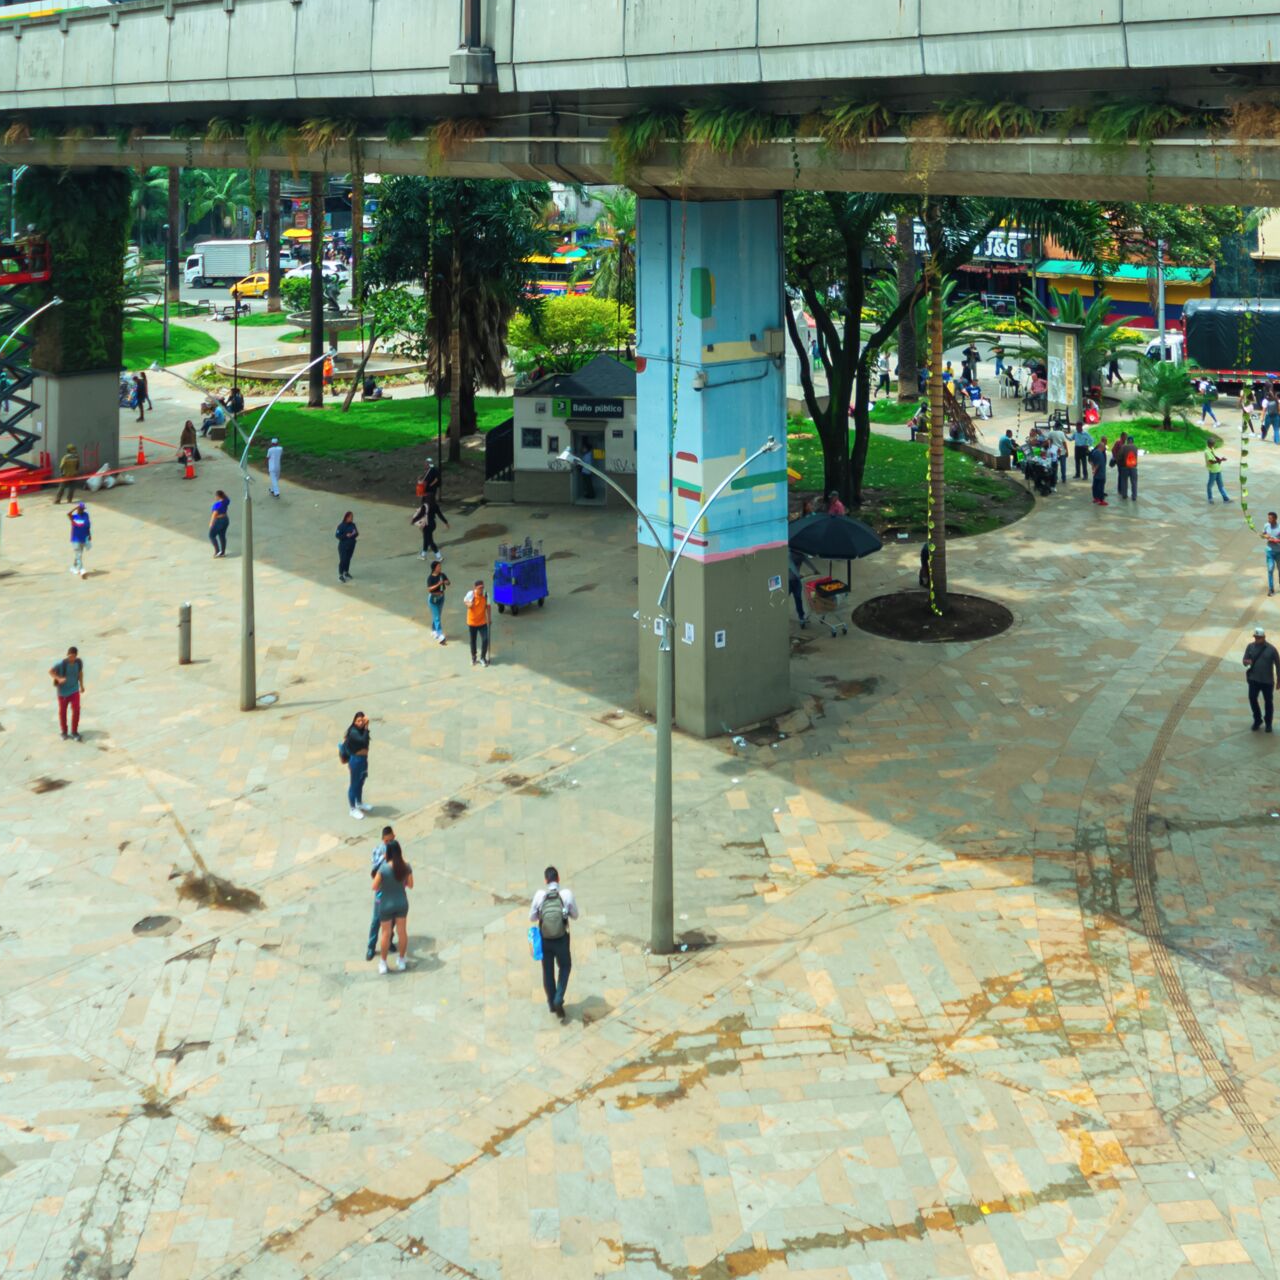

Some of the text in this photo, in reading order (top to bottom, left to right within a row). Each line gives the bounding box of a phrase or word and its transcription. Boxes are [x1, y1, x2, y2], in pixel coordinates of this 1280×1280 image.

[985, 237, 1018, 258] J&G
[573, 404, 622, 413] Baño público
